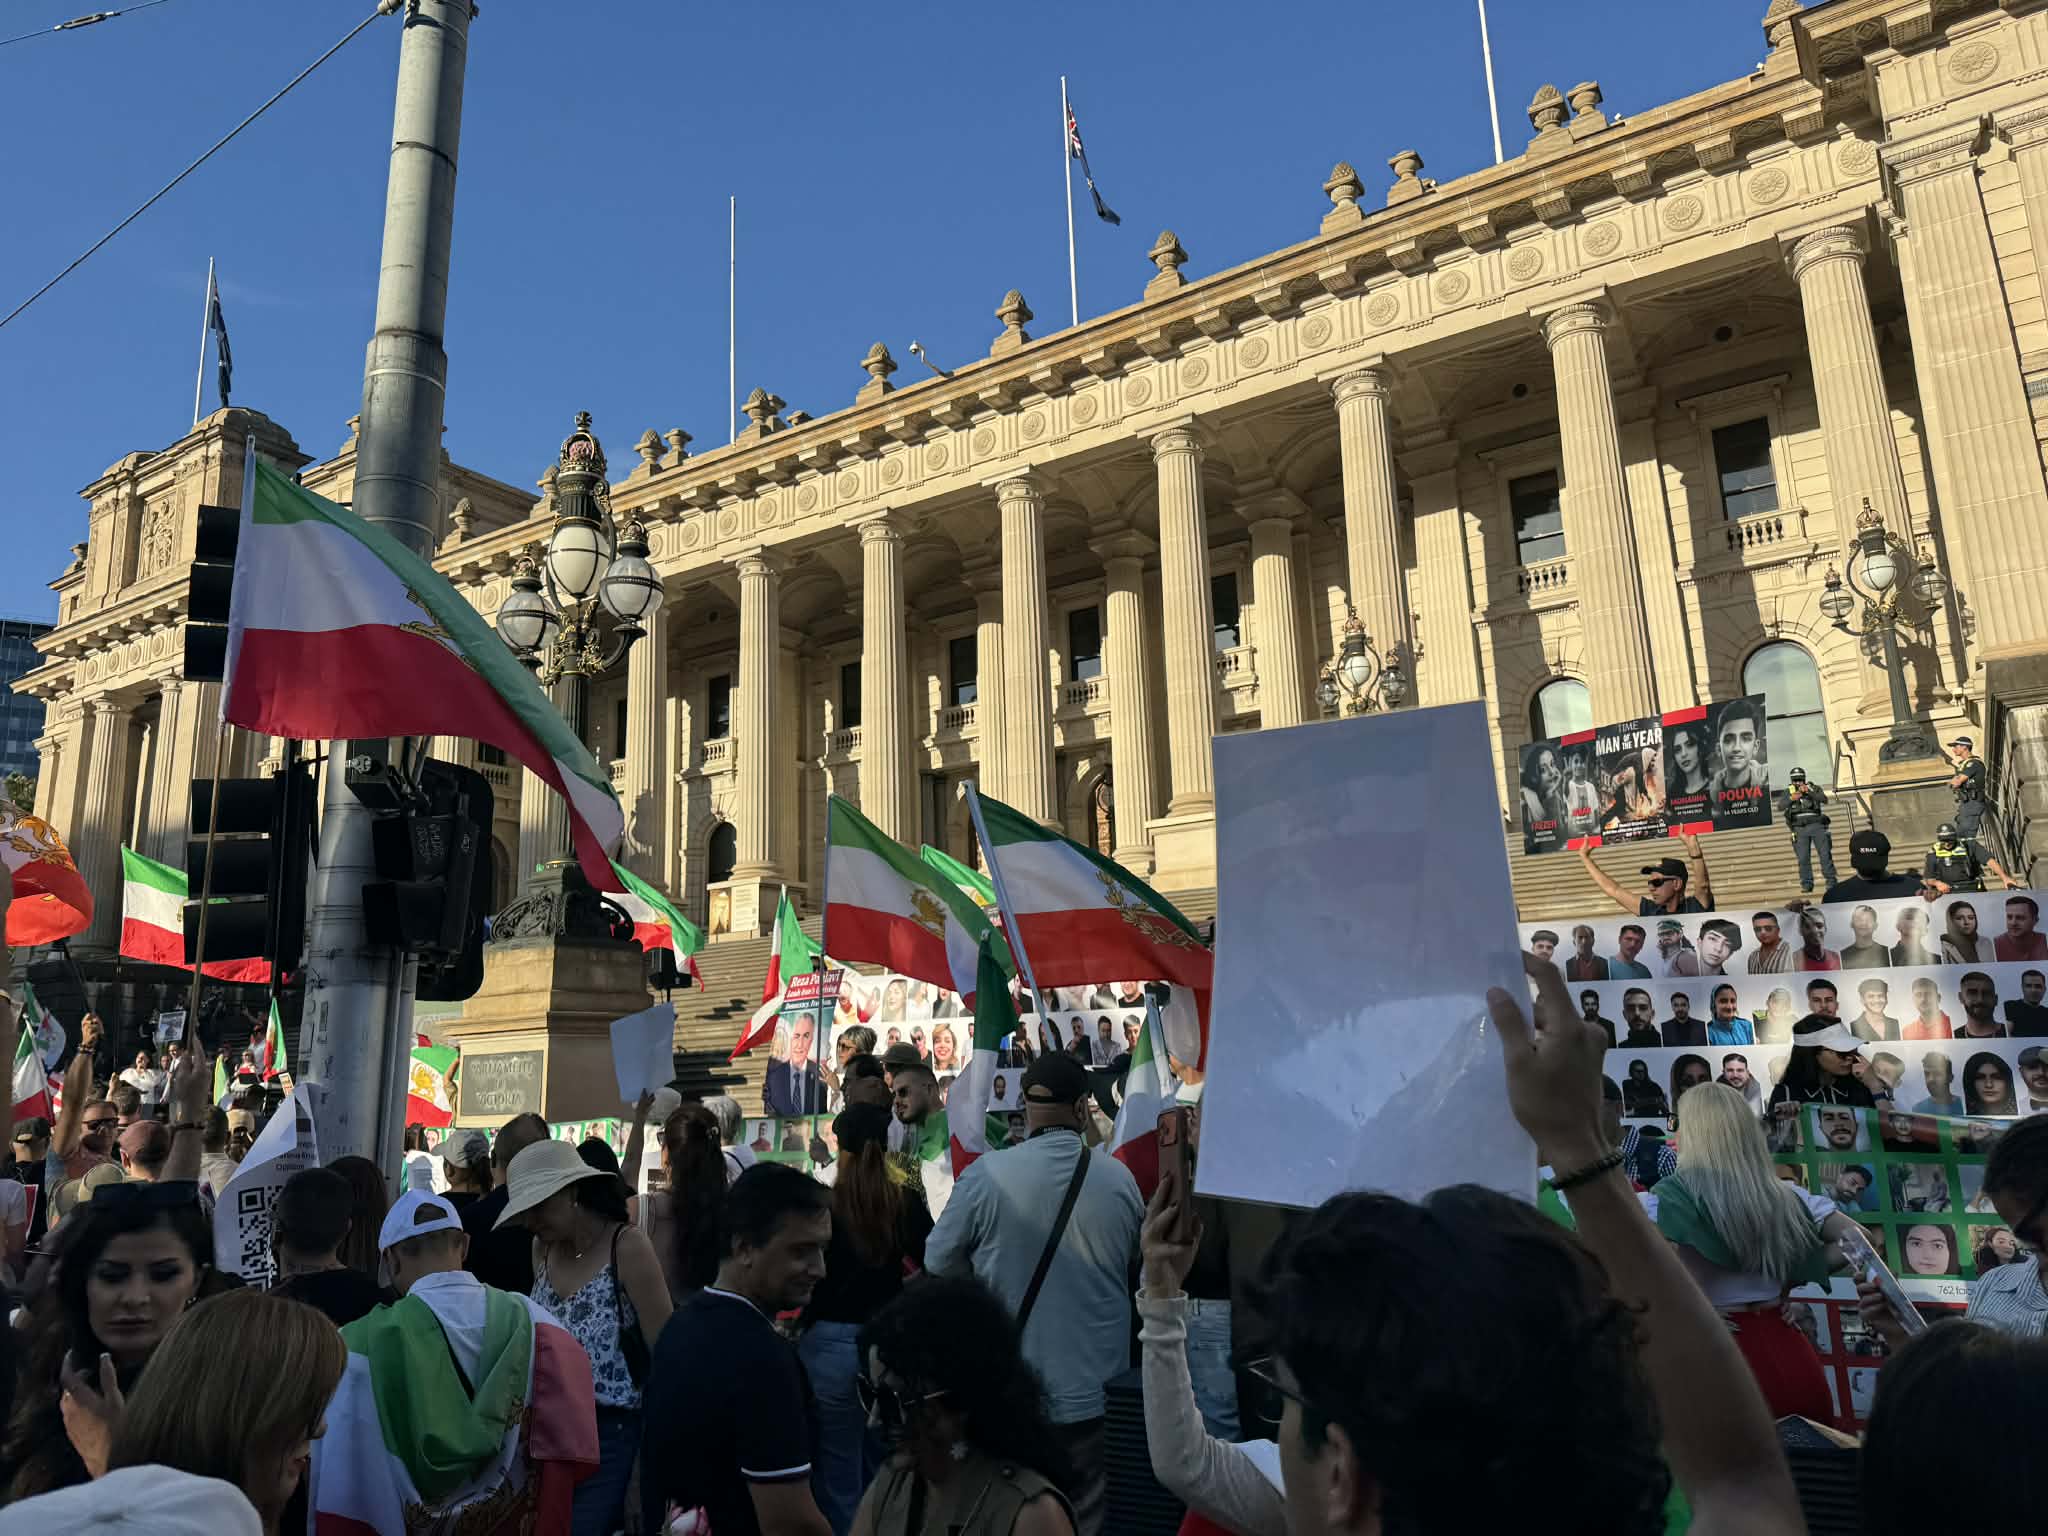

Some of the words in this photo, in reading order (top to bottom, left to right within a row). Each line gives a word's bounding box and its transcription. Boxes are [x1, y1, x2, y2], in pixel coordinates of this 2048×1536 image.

[1595, 736, 1620, 757] MAN
[1622, 740, 1633, 751] THE
[1633, 727, 1663, 749] YEAR
[1718, 784, 1764, 804] POUYA
[790, 976, 809, 988] Reza
[810, 971, 840, 985] Palavi
[474, 1091, 523, 1105] VICTORIA
